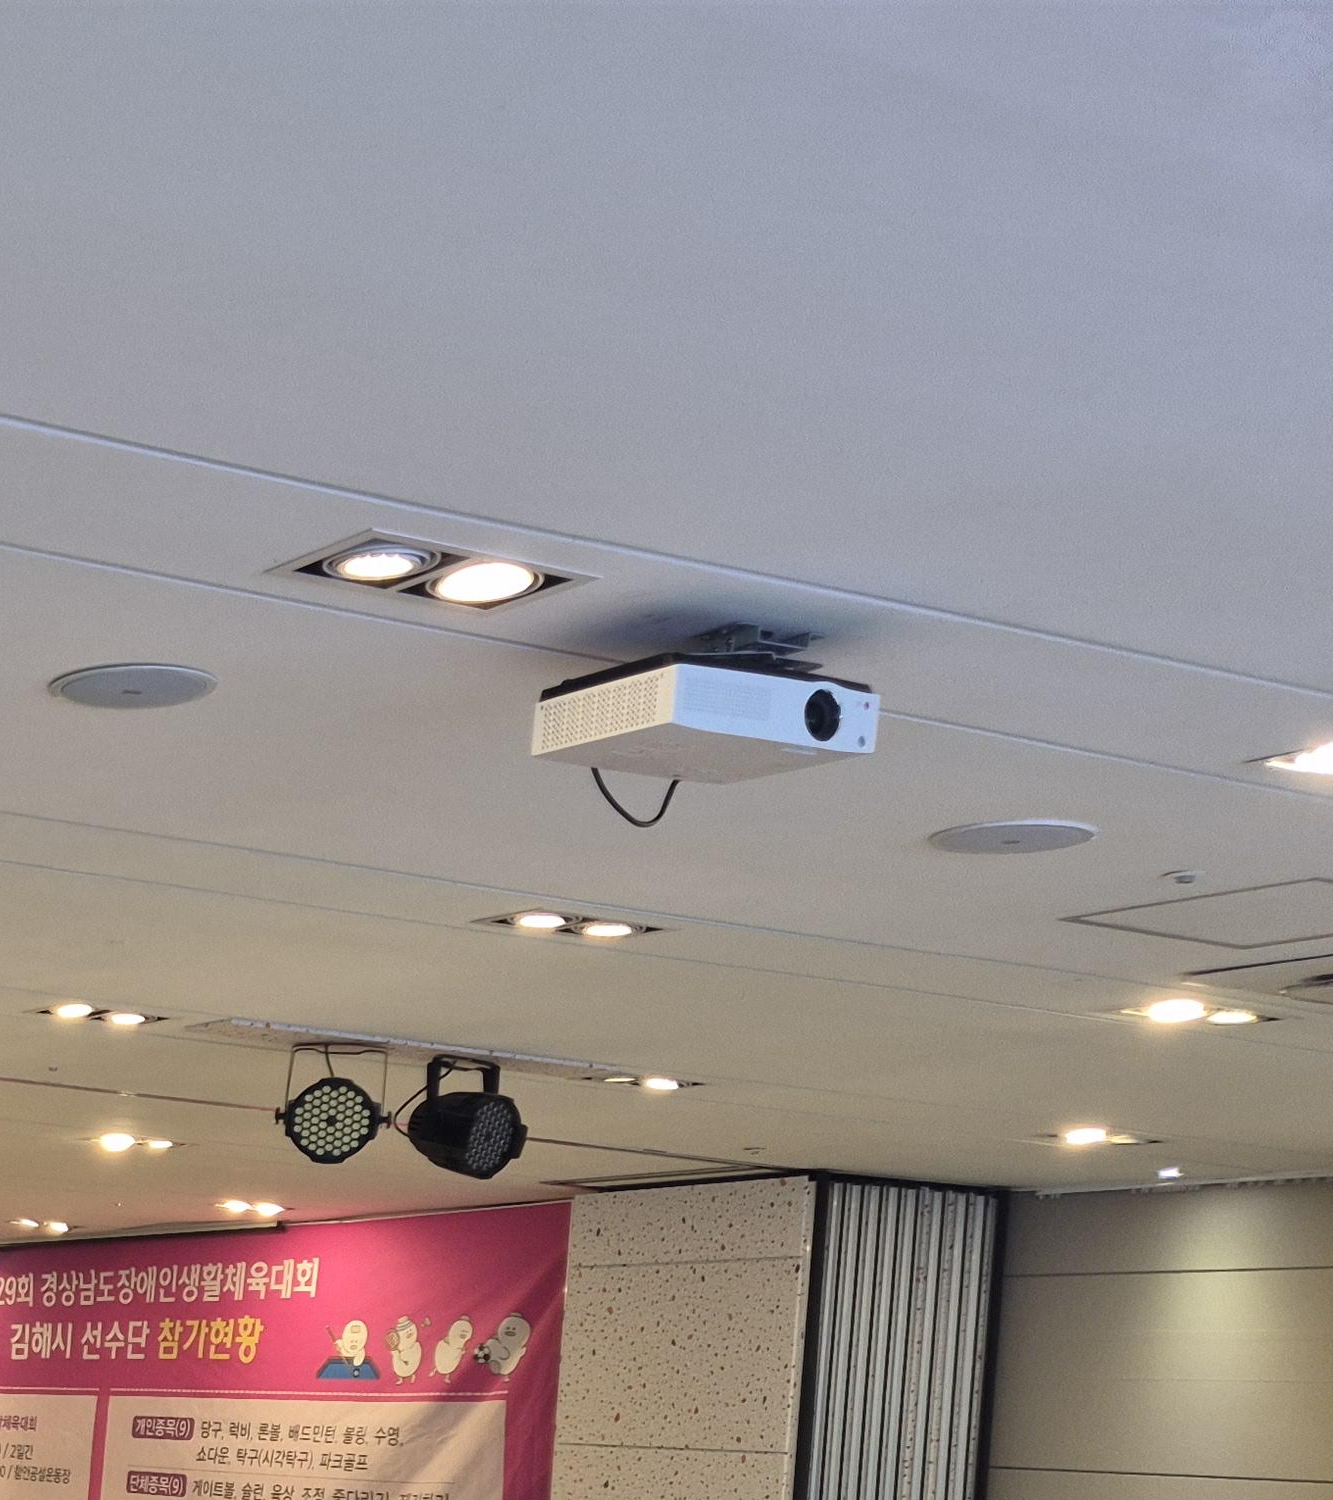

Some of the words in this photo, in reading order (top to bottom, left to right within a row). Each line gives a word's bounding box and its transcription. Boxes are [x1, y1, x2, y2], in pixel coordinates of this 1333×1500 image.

[40, 1257, 320, 1308] 경상남도장애인생활체육대회
[10, 1321, 72, 1361] 김해시
[81, 1320, 151, 1360] 선수단
[157, 1315, 264, 1364] 참가현황
[134, 1417, 193, 1438] 개인종목(9)
[201, 1420, 225, 1441] 당구,
[229, 1422, 252, 1442] 럭비,
[374, 1427, 405, 1447] 수영,
[319, 1453, 369, 1472] 파크골프
[129, 1474, 185, 1495] 단체종목(9)
[192, 1479, 237, 1498] 게이트볼,
